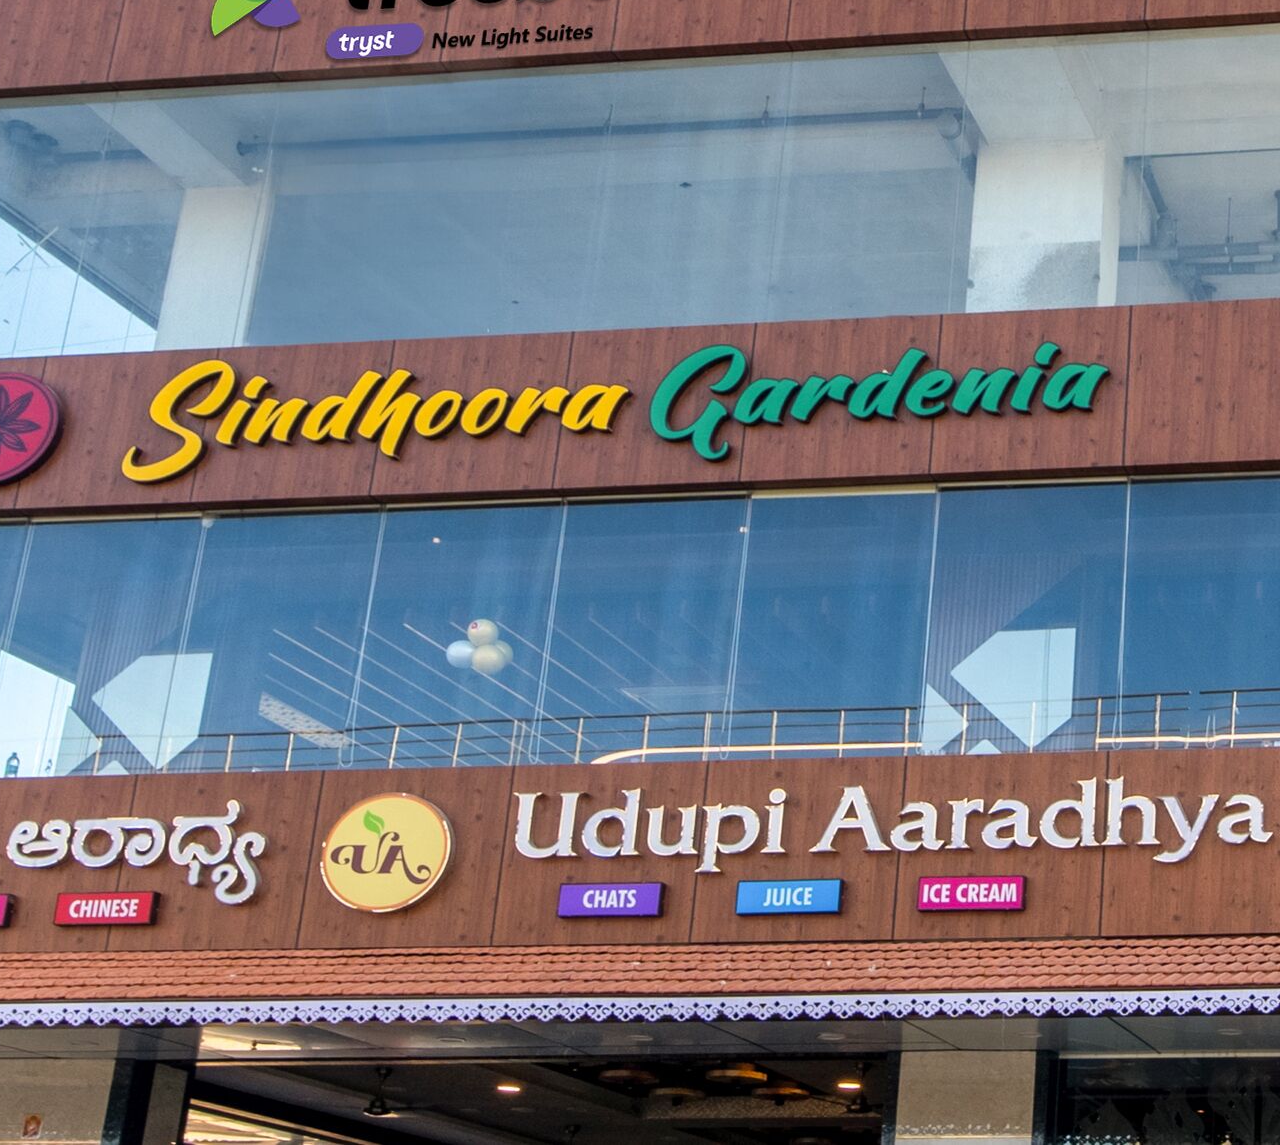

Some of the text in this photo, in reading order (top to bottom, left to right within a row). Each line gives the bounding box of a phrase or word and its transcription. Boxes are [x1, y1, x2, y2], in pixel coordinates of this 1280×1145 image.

[338, 30, 395, 57] tryst
[431, 24, 594, 50] New Light Suites
[120, 340, 1111, 484] Sindhoora Gardenia
[513, 775, 1274, 875] Udupi Aaradhya
[6, 799, 270, 906] ಆರಾಧ್ಯ
[582, 887, 638, 911] CHATS
[762, 885, 814, 908] JUICE
[921, 880, 1018, 905] ICE CREAM
[68, 898, 140, 919] CHINESE
